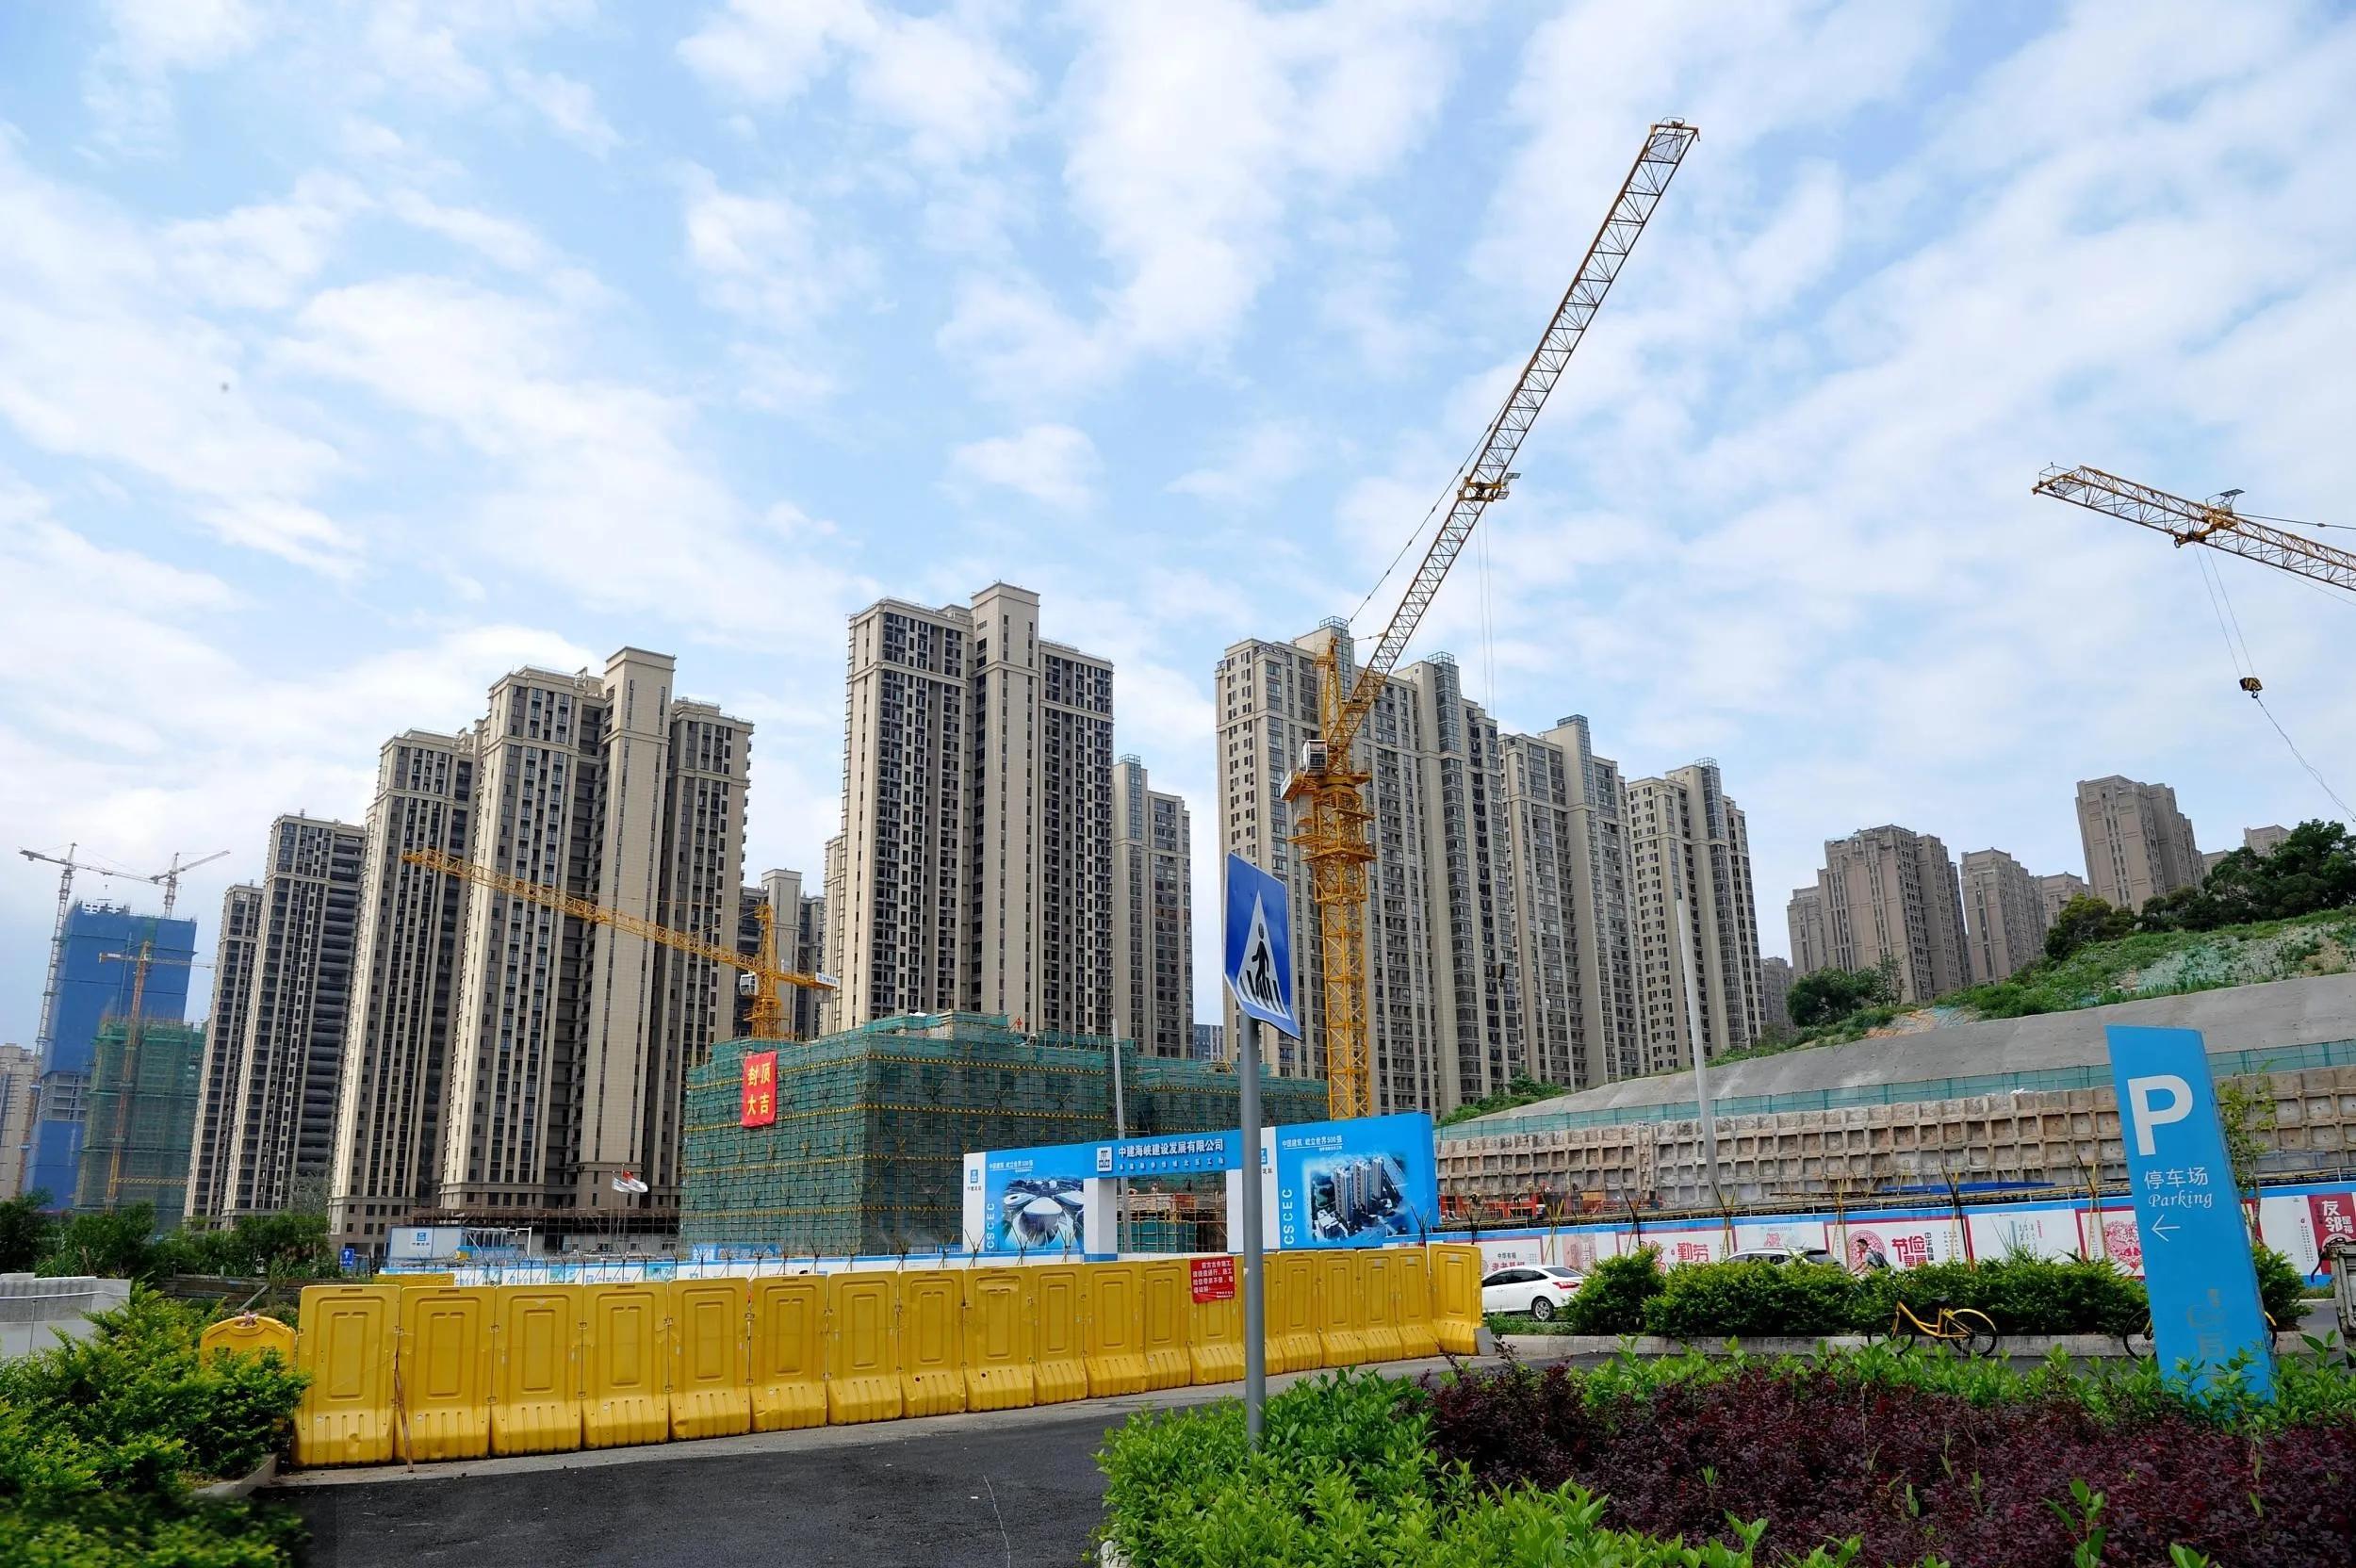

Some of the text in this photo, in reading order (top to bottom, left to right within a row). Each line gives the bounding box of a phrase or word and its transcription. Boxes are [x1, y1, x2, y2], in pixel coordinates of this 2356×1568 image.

[747, 1062, 771, 1086] 封顶
[746, 1092, 770, 1116] 大吉
[2127, 1074, 2194, 1156] P
[1119, 1138, 1224, 1158] 中建海峡建设发展有限公司
[2144, 1167, 2209, 1190] 停车场
[2148, 1190, 2213, 1208] Parking
[987, 1203, 995, 1249] CSCEC
[1282, 1188, 1295, 1245] CSCEC
[1677, 1242, 1710, 1263] 勤劳
[1891, 1235, 1925, 1262] 节俭
